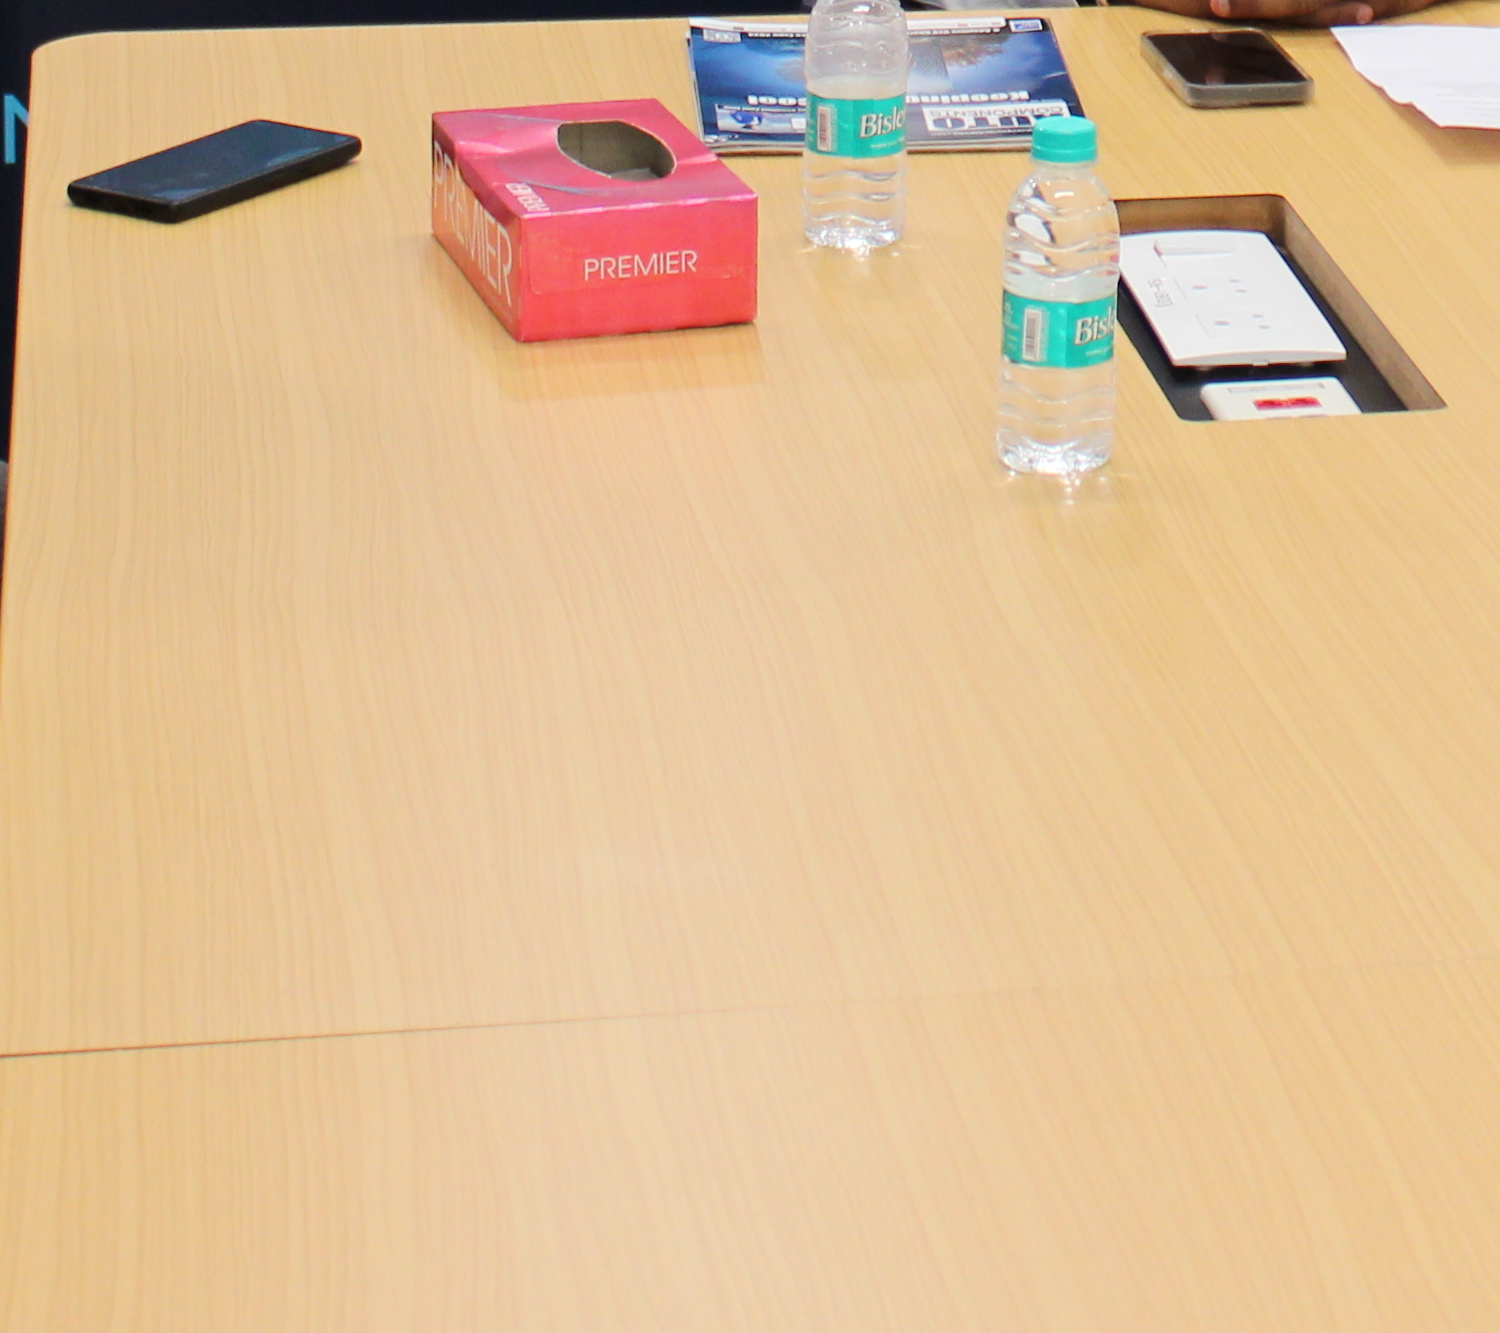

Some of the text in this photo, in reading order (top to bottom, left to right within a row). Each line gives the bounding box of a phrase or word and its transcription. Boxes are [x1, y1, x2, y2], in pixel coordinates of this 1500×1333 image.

[859, 105, 906, 139] Bisle
[930, 105, 1064, 118] COMPONENTS
[584, 249, 698, 281] PREMIER
